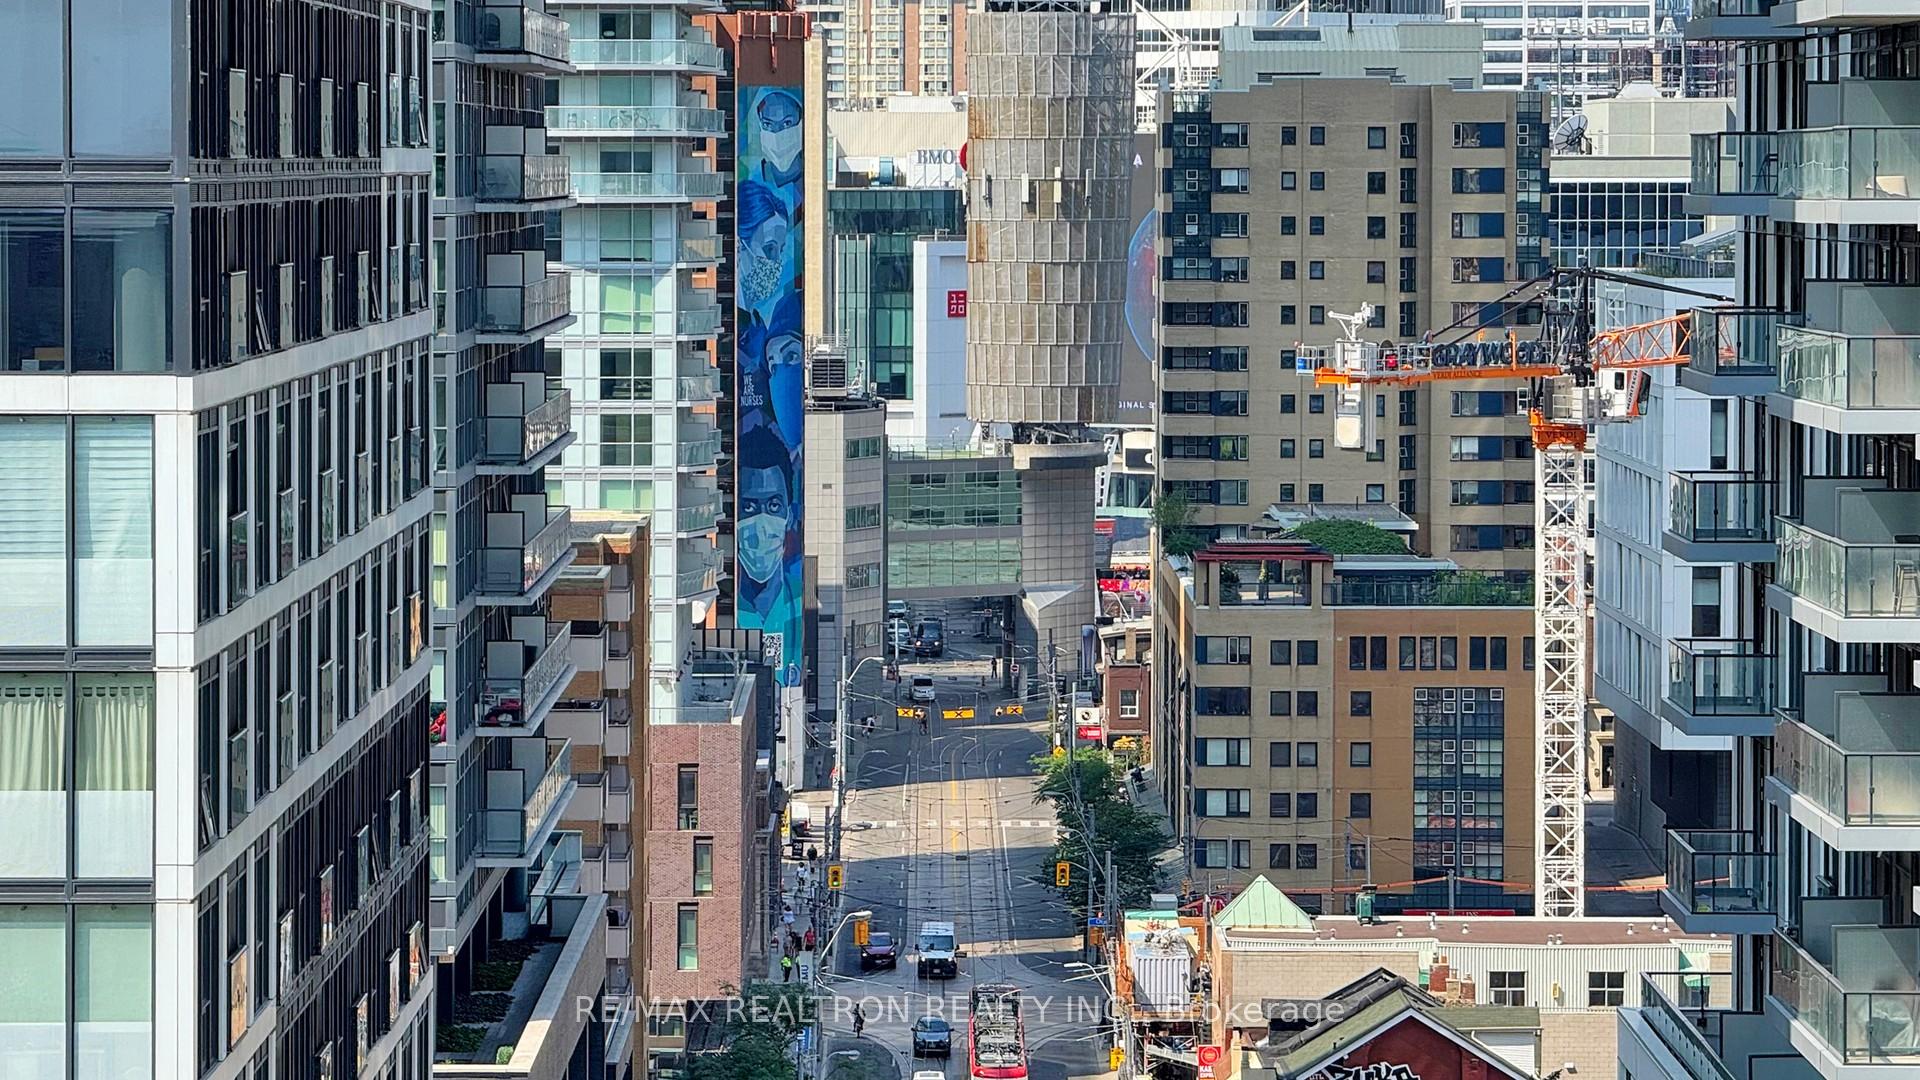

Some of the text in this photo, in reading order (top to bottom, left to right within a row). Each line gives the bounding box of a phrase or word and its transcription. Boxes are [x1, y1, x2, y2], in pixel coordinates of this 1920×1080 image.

[917, 149, 955, 165] BMO
[1432, 341, 1544, 366] GRAYWOOD
[743, 374, 753, 385] WE
[743, 384, 755, 396] ARE
[740, 394, 764, 407] NURSES
[1545, 431, 1577, 439] VERDI
